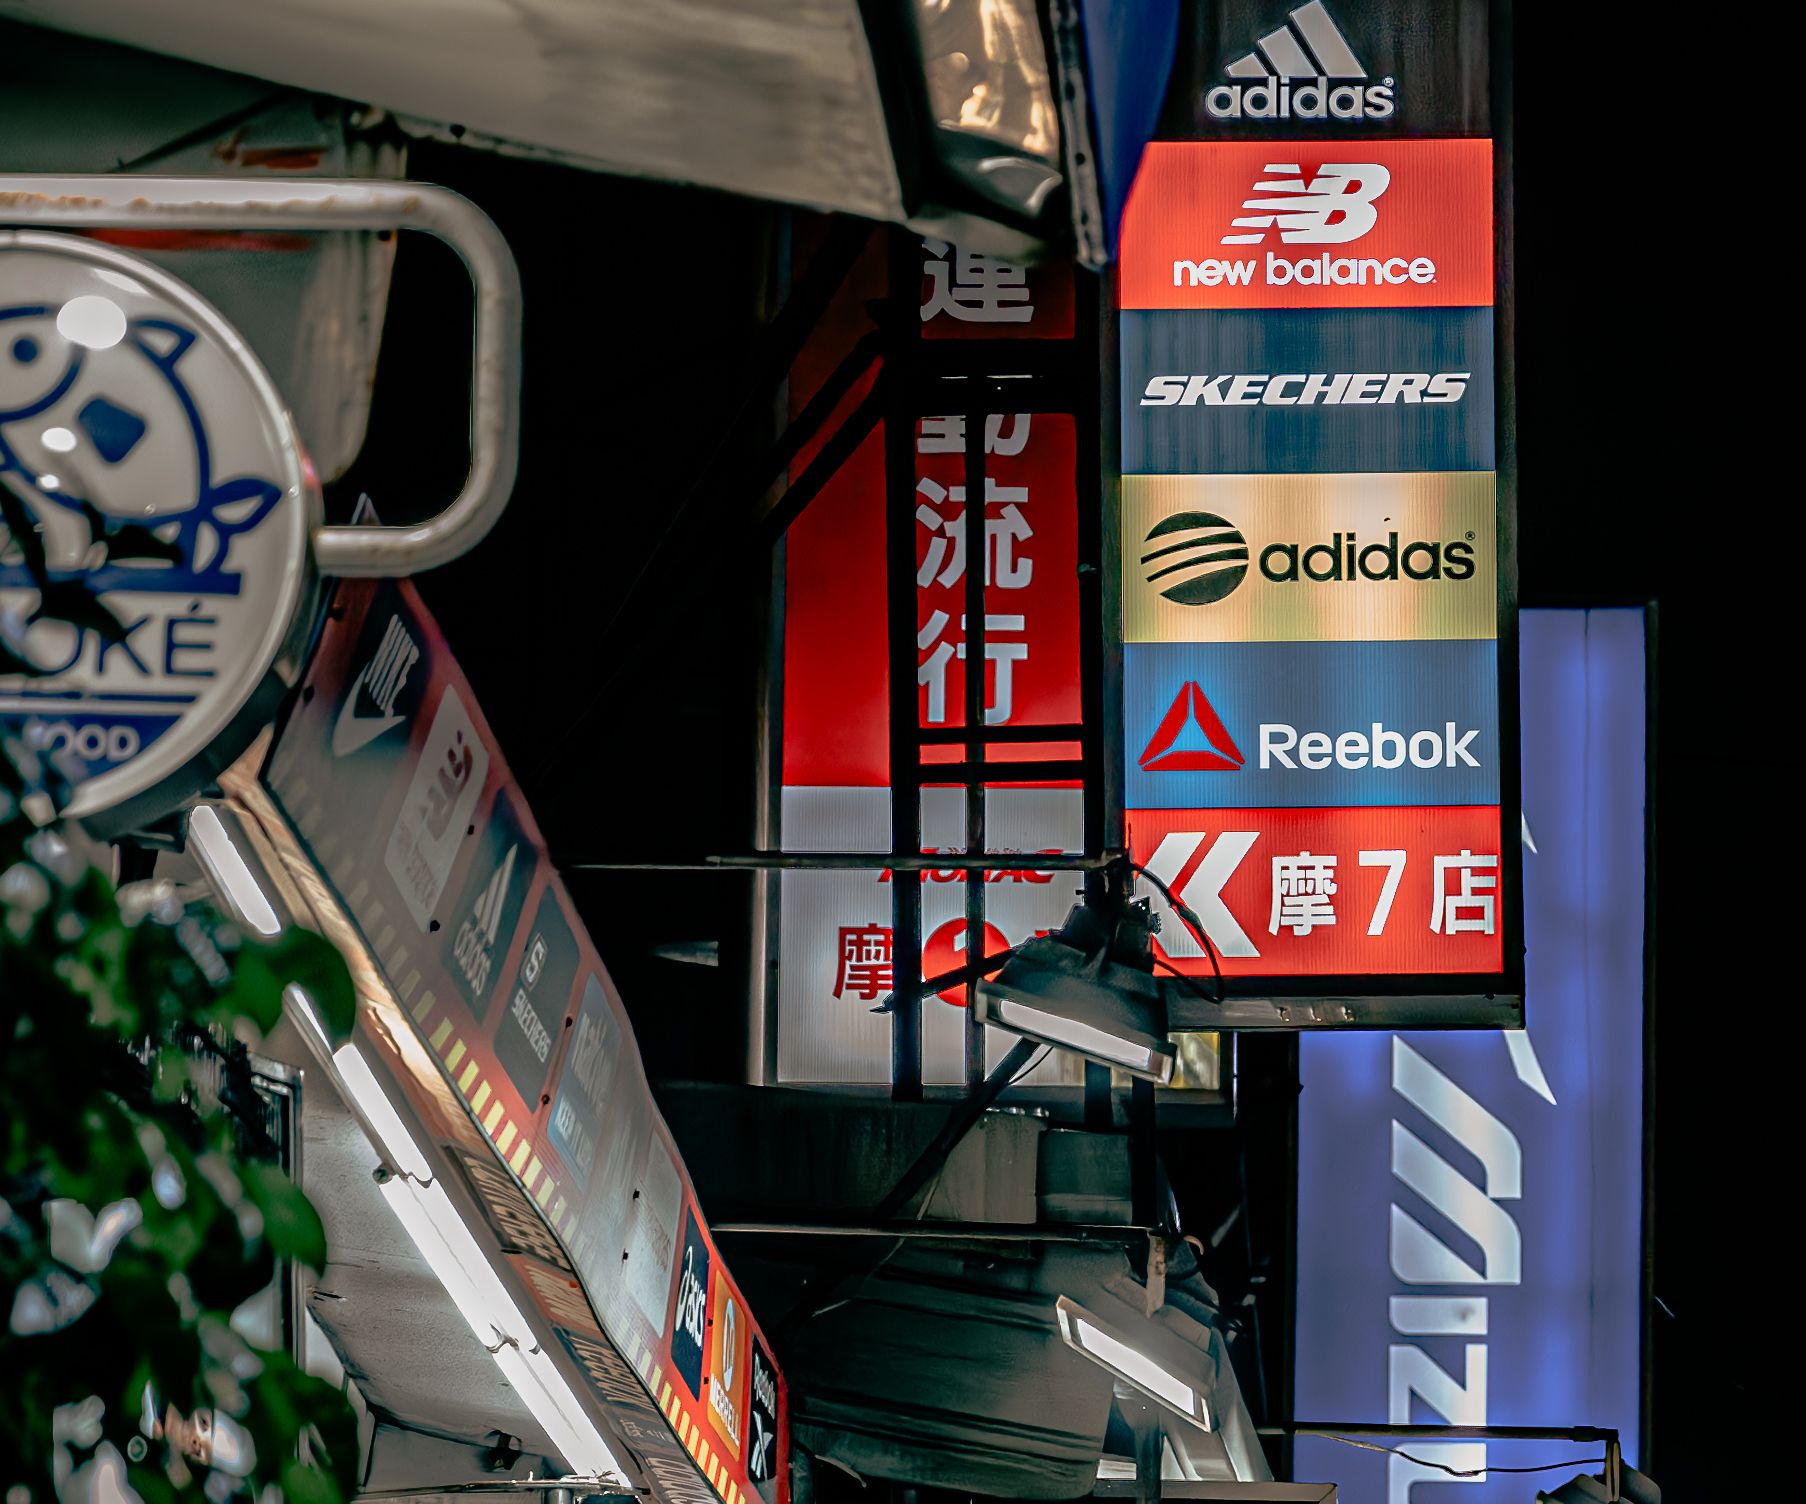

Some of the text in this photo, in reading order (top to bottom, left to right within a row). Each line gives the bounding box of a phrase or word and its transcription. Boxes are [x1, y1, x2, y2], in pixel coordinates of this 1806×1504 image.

[1206, 78, 1391, 120] adidas
[1172, 252, 1434, 287] new balance
[1141, 372, 1470, 407] SKECHERS
[1259, 534, 1473, 584] adidas
[1258, 722, 1480, 771] Reebok
[1267, 848, 1499, 941] 摩7店
[511, 988, 552, 1063] SKECHERS
[710, 1373, 740, 1448] MERRELL
